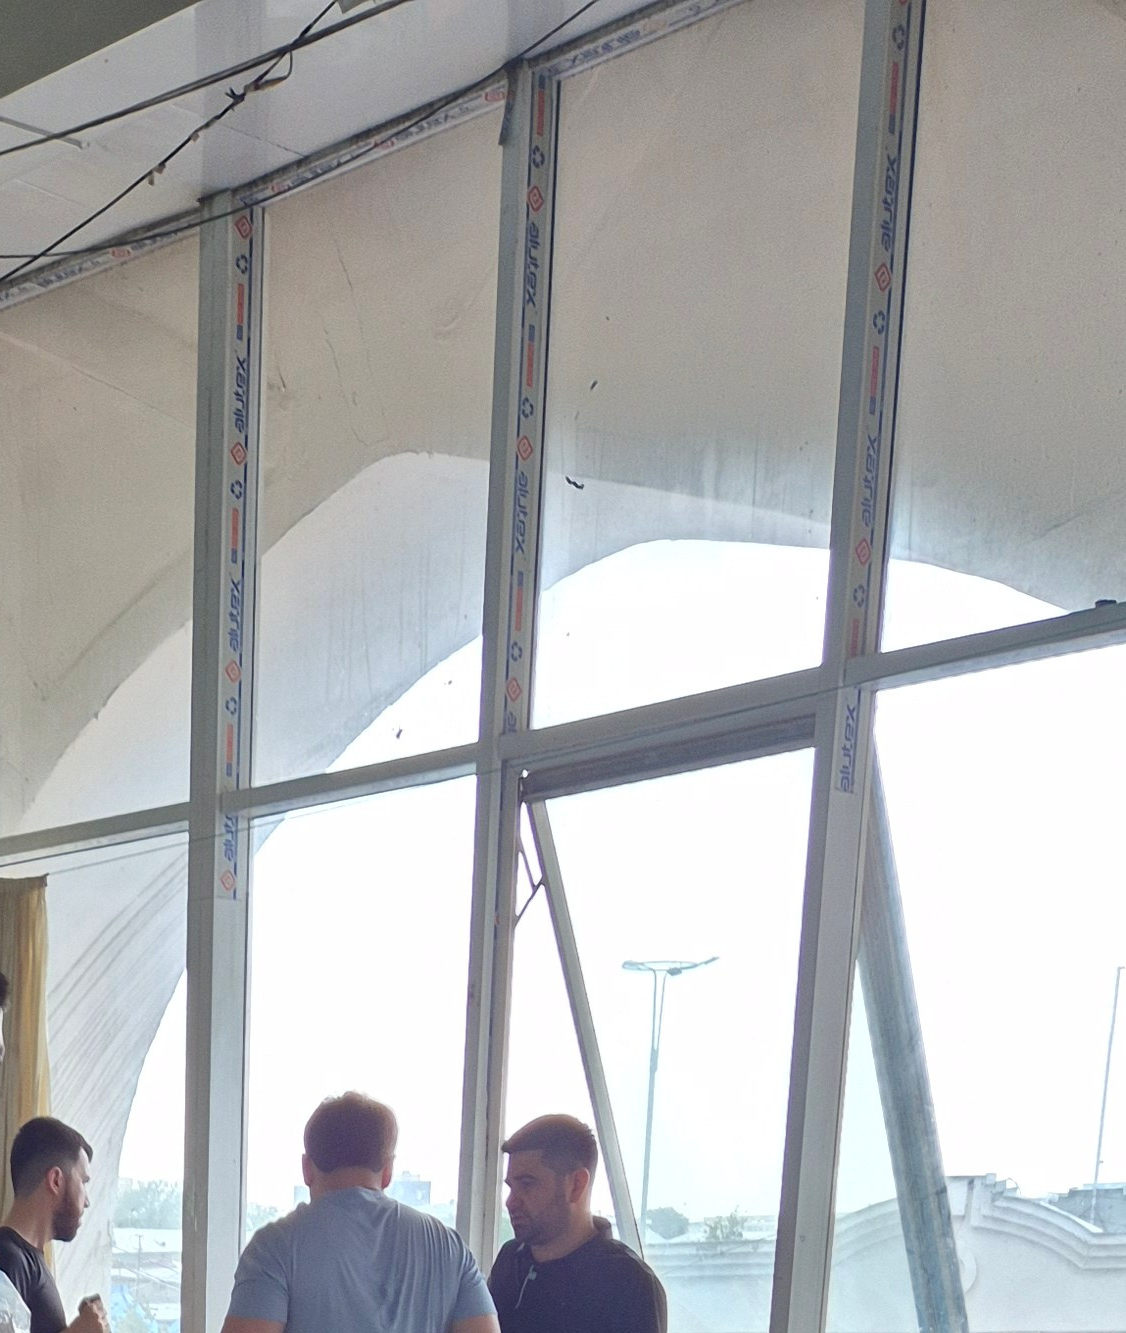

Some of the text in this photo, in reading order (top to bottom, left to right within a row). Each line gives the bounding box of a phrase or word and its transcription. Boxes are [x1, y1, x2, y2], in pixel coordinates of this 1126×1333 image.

[880, 154, 897, 252] alutex
[525, 222, 540, 307] alutex
[233, 356, 246, 433] alutex
[515, 471, 530, 553] alutex
[862, 433, 877, 528] alutex
[228, 578, 241, 652] alutex
[840, 703, 857, 793] alutex
